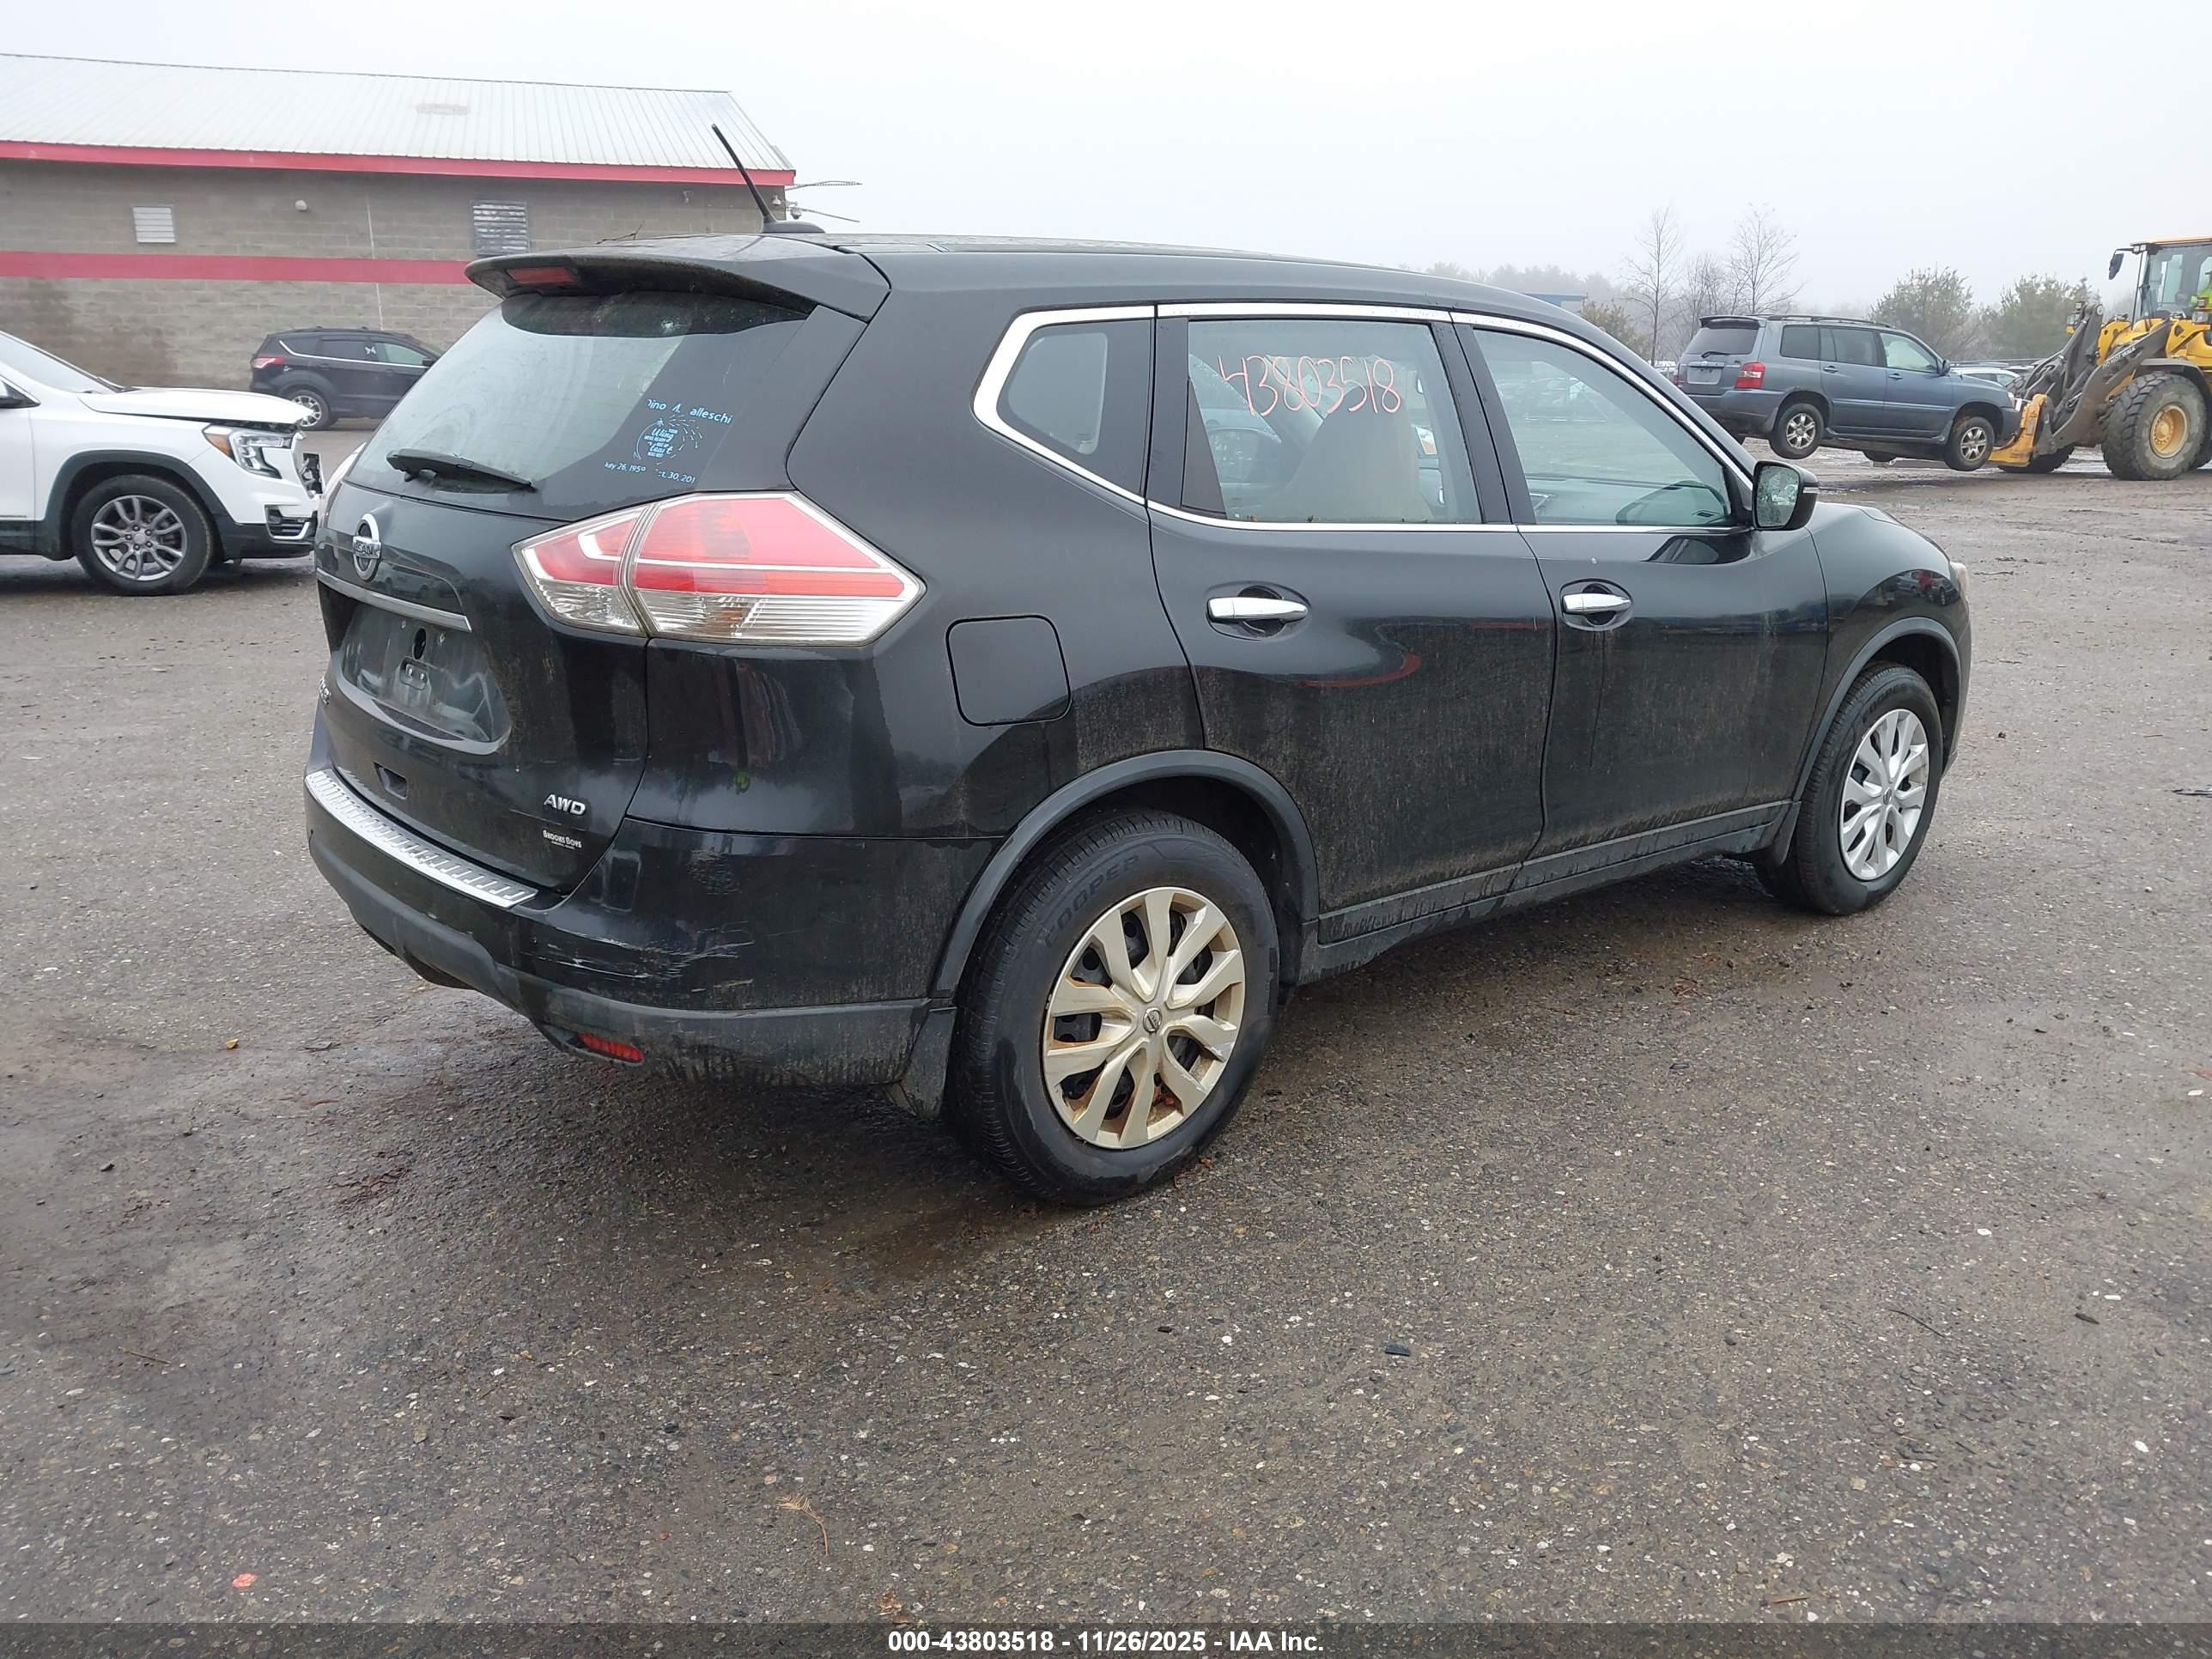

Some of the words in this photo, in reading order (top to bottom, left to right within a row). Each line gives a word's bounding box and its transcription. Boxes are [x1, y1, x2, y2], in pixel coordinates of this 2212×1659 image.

[1218, 355, 1401, 416] 43803518
[543, 793, 586, 816] AWD
[1044, 854, 1139, 948] COOPER
